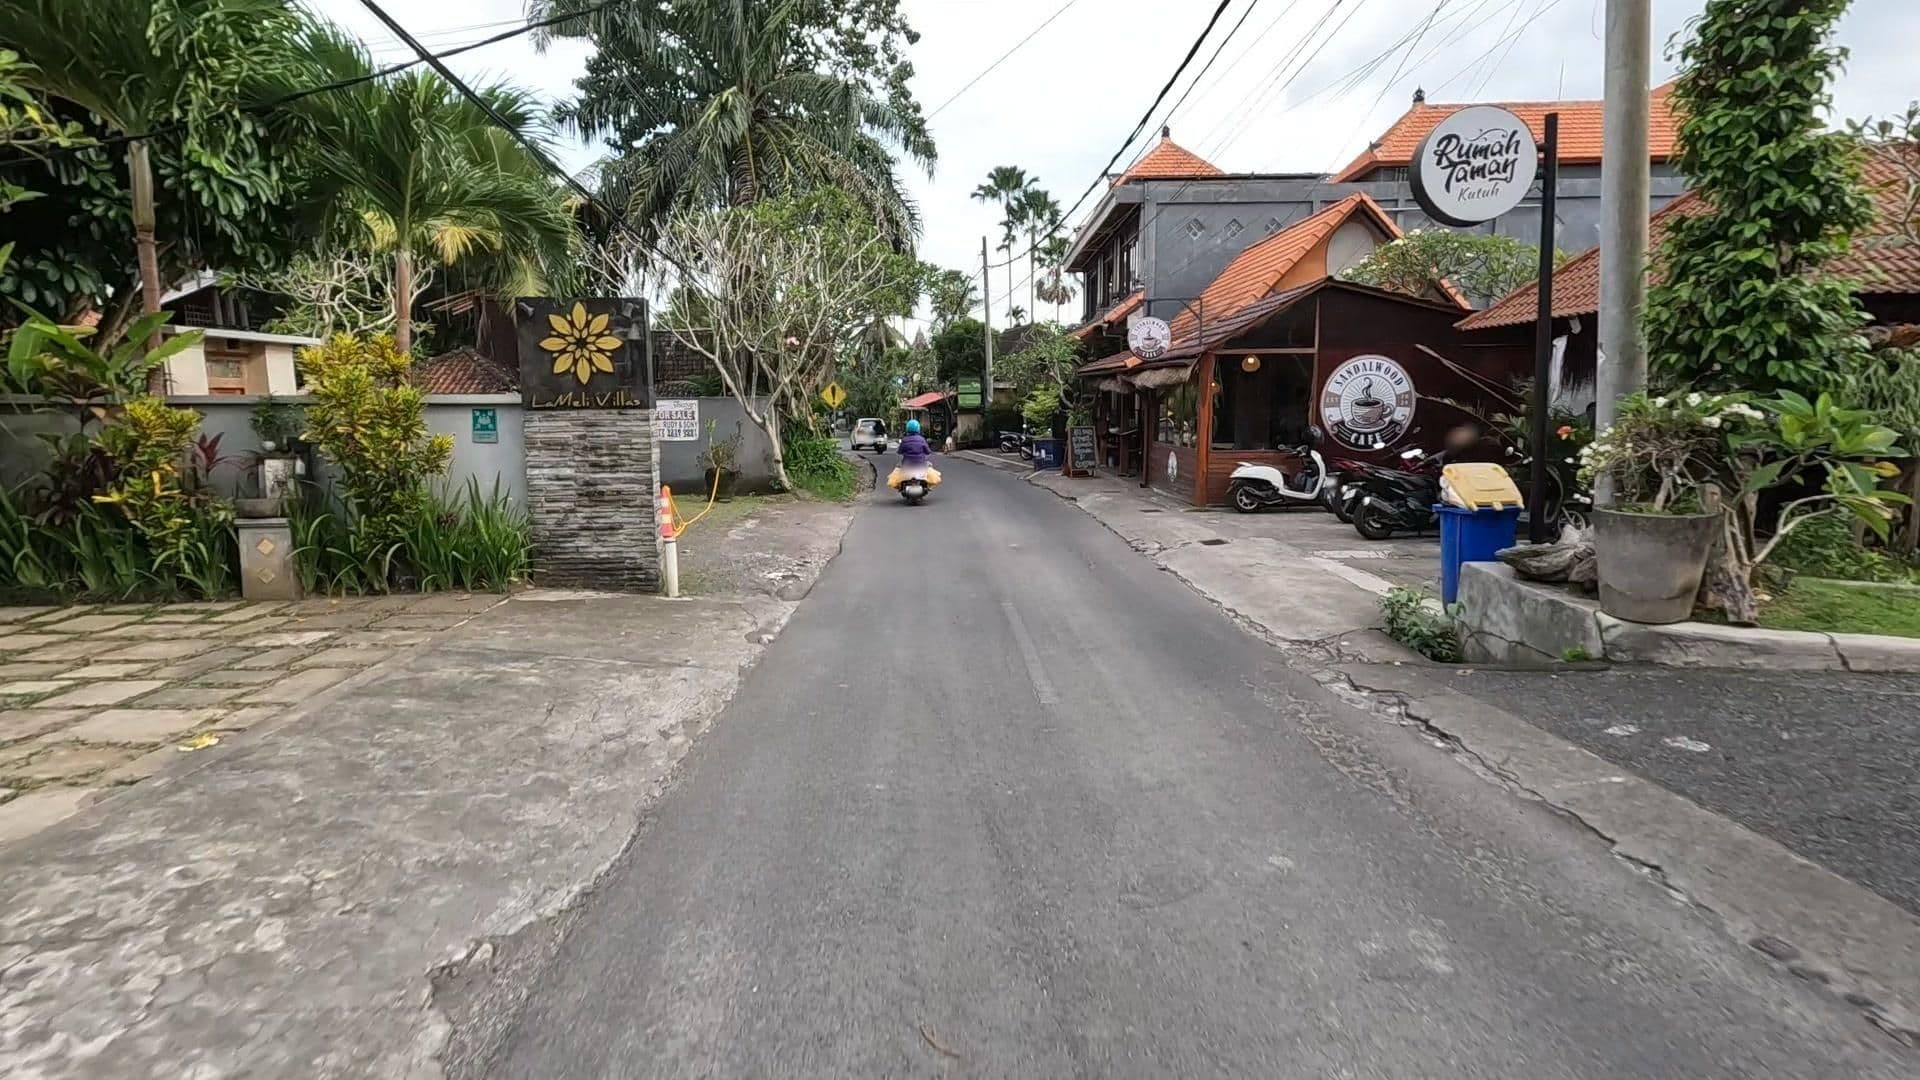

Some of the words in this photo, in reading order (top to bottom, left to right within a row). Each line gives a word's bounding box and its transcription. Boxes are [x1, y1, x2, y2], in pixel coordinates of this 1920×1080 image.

[1433, 129, 1520, 167] Rumah
[1457, 182, 1500, 202] Kutuh
[1334, 361, 1404, 387] SANDALWOOD
[596, 389, 641, 407] Villas
[1350, 432, 1383, 445] CAFE
